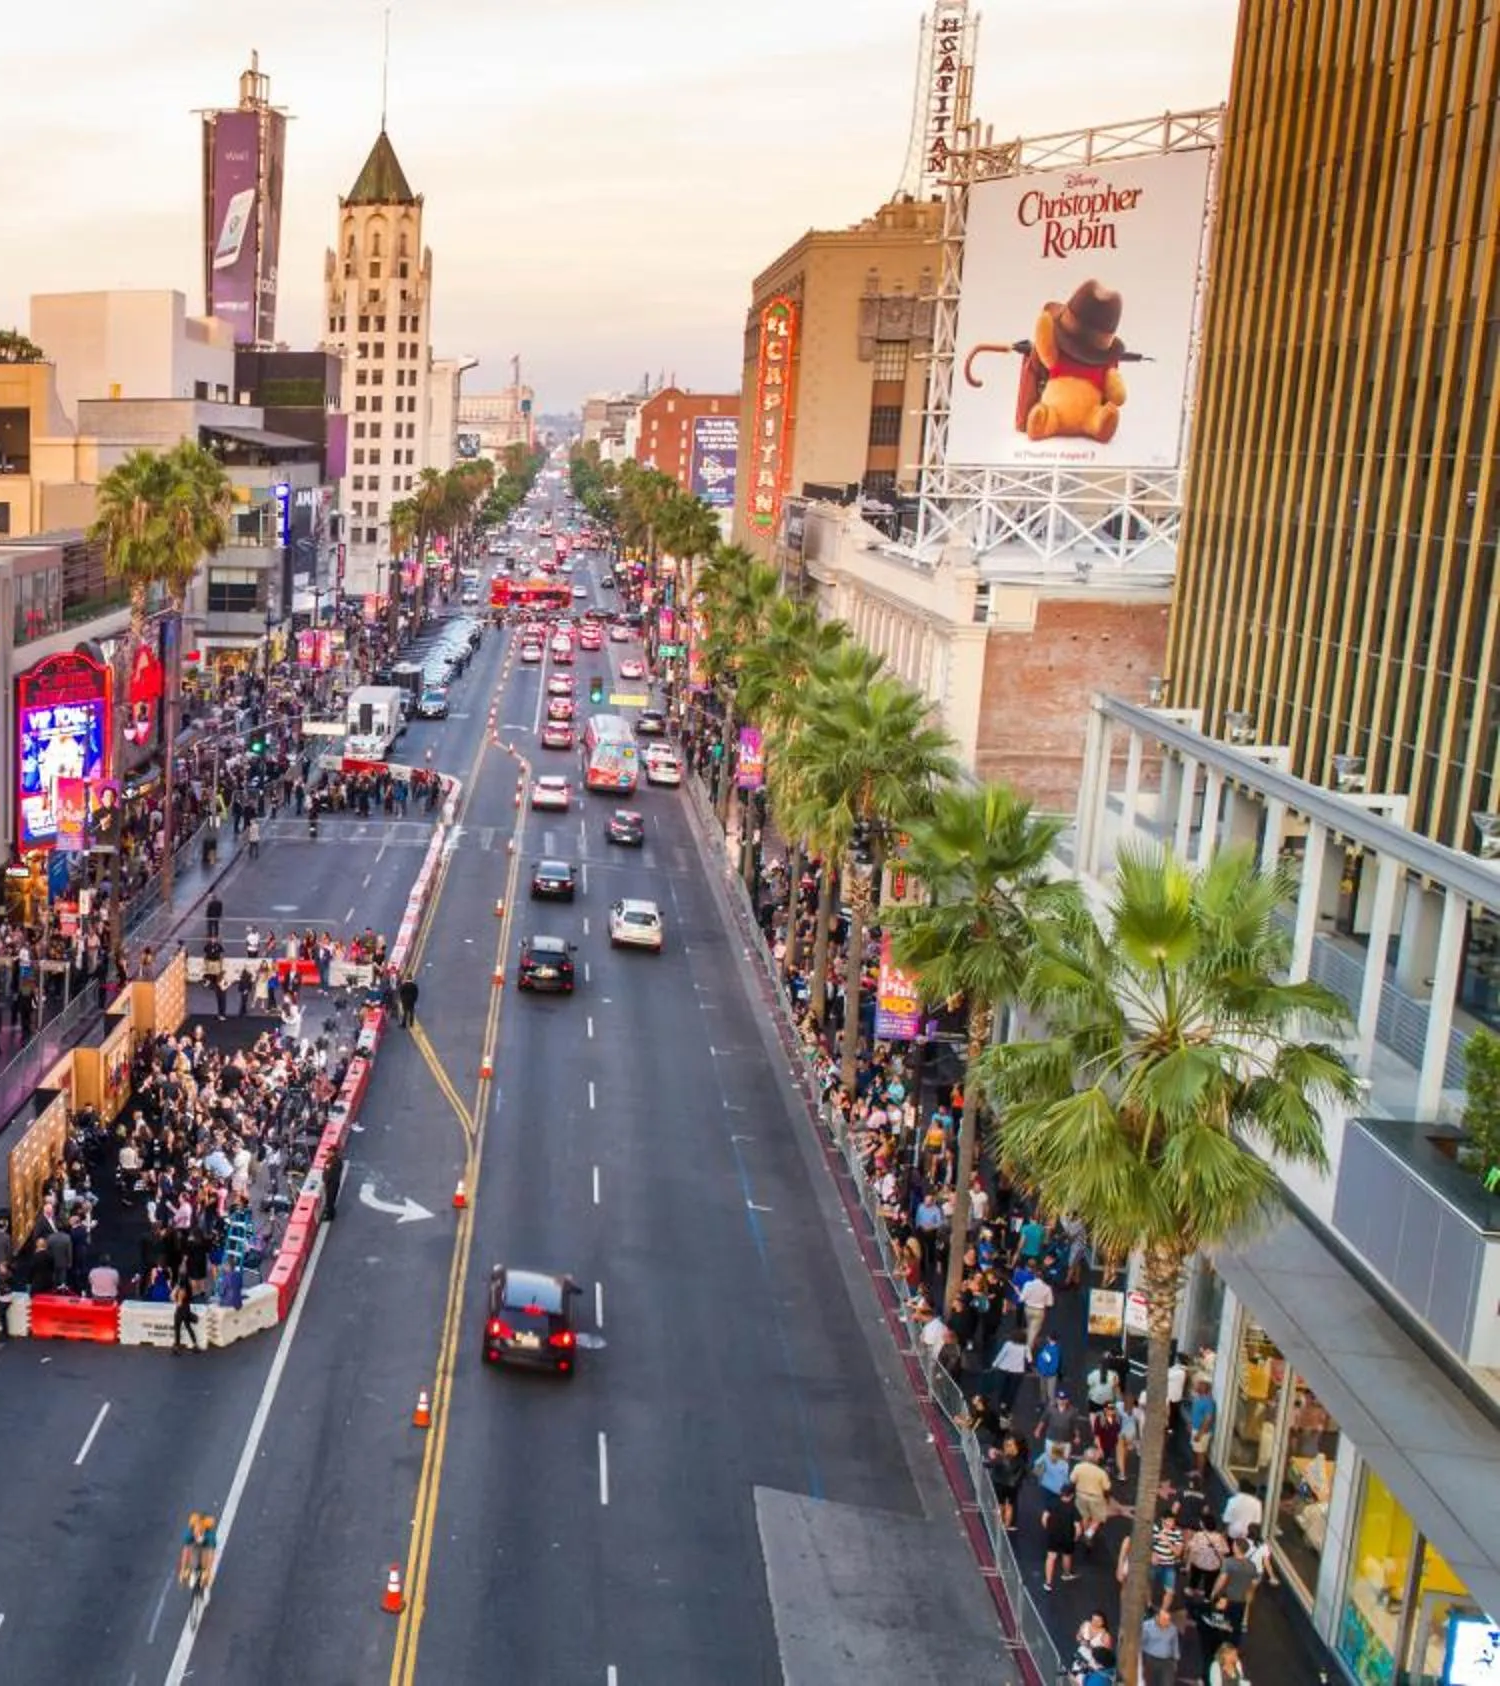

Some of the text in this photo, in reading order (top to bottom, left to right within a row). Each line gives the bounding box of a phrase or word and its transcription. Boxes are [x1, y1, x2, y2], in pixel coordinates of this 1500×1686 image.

[1064, 173, 1100, 189] Disney
[1018, 183, 1143, 227] Christopher
[1042, 218, 1118, 258] Robin
[767, 317, 788, 337] EL
[755, 341, 783, 513] CAPITAN
